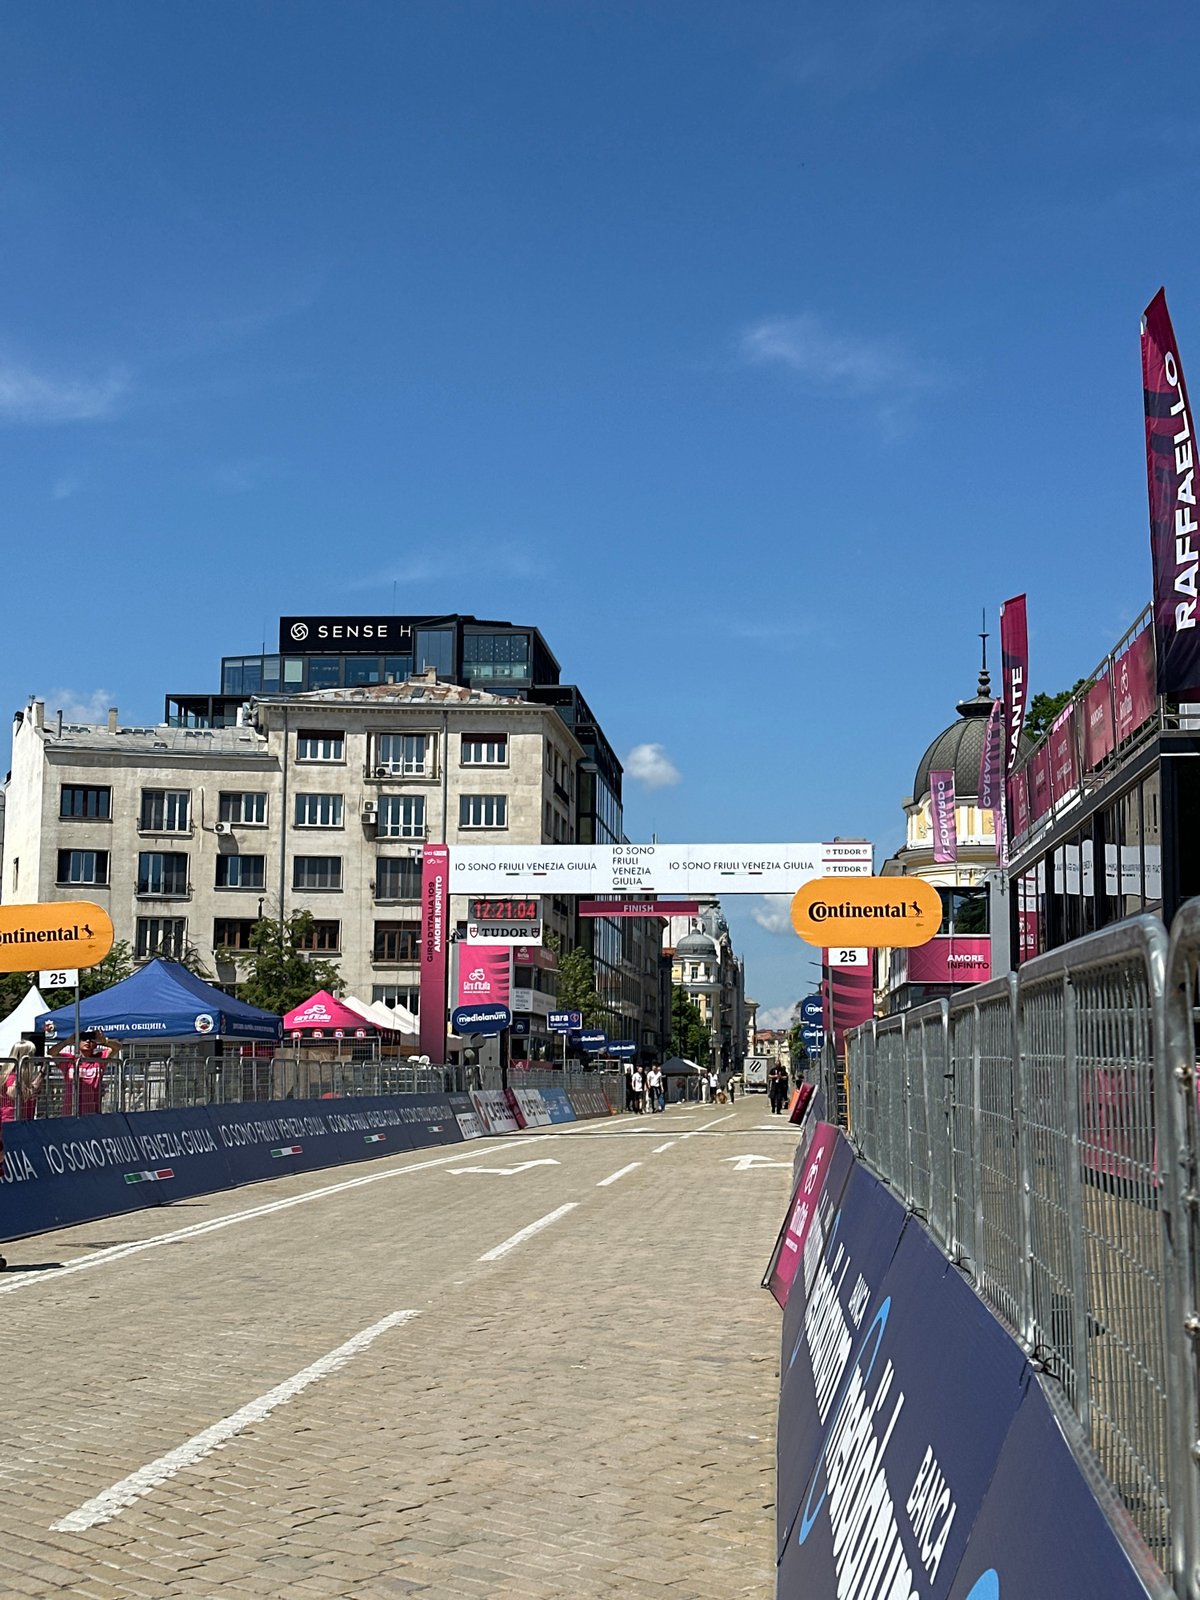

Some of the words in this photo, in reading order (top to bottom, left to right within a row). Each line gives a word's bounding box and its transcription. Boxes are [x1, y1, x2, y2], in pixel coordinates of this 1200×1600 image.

[1166, 351, 1200, 632] RAFFAELLO
[318, 625, 388, 638] SENSE
[400, 625, 411, 637] H
[612, 847, 624, 855] IO
[626, 847, 655, 855] SONO
[455, 862, 466, 871] IO
[468, 862, 497, 871] SONO
[499, 862, 525, 871] FRIULI
[526, 862, 566, 871] VENEZIA
[567, 862, 597, 870] GIULIA
[612, 857, 639, 865] FRIULI
[669, 862, 680, 870] IO
[682, 861, 711, 870] SONO
[713, 862, 740, 870] FRIULI
[742, 862, 781, 870] VENEZIA
[783, 861, 814, 870] GIULIA
[612, 867, 651, 875] VENEZIA
[612, 877, 643, 885] GIULIA
[435, 876, 443, 916] INFINITO
[474, 901, 536, 918] 12:21:04
[808, 901, 907, 922] Continental
[427, 900, 435, 938] D'ITALIA
[0, 926, 79, 944] ntinental
[481, 928, 528, 937] TUDOR
[840, 950, 857, 962] 25
[50, 973, 66, 985] 25
[459, 1012, 507, 1023] mediolanum
[218, 1125, 233, 1147] IO
[230, 1122, 258, 1146] SONO
[254, 1120, 281, 1142] FRIULI
[275, 1118, 309, 1139] VENEZIA
[0, 1149, 38, 1184] ULIA
[42, 1144, 65, 1174] IO
[62, 1139, 105, 1172] SONO
[102, 1136, 139, 1166] FRIULI
[135, 1132, 186, 1161] VENEZIA
[181, 1128, 218, 1155] GIULIA
[906, 1444, 957, 1585] BANCA
